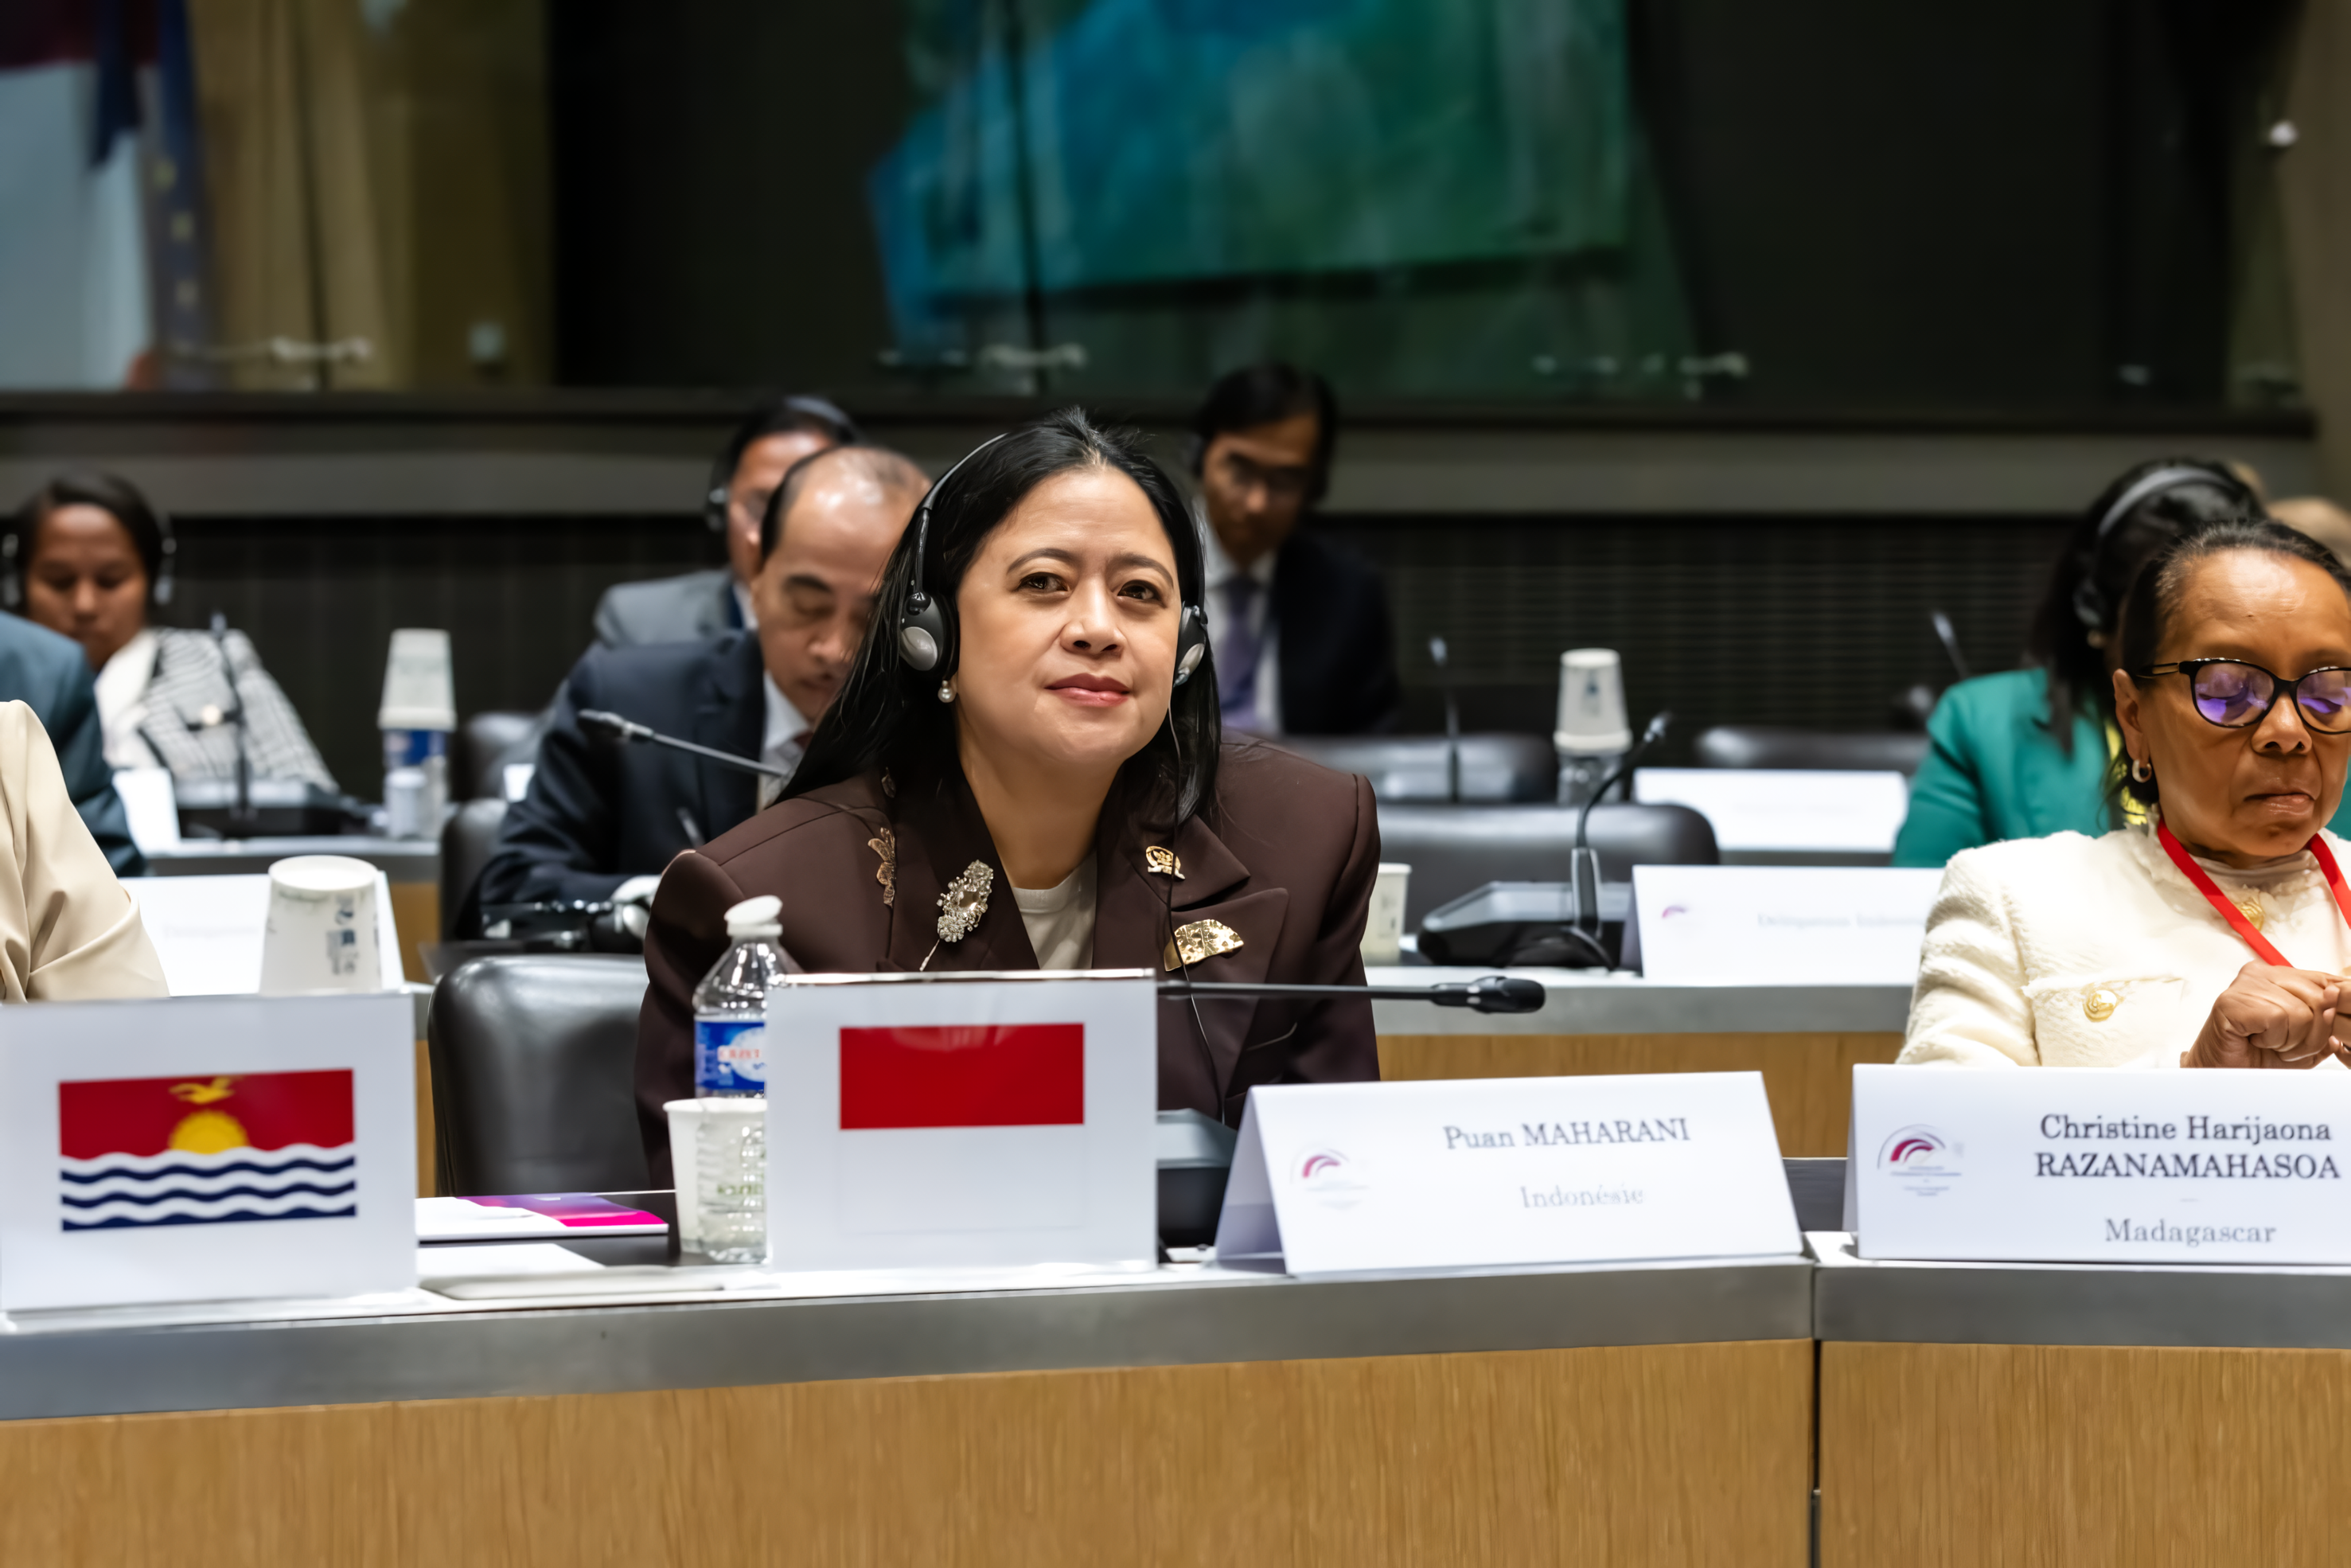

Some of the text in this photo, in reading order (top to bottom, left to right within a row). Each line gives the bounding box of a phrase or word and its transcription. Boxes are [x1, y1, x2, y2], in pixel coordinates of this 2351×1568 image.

[1443, 1117, 1690, 1149] Puan MAHARANI
[2041, 1114, 2332, 1145] Christine Harijaona
[2035, 1153, 2341, 1179] RAZANAMAHASOA
[2105, 1218, 2276, 1246] Madagascar
